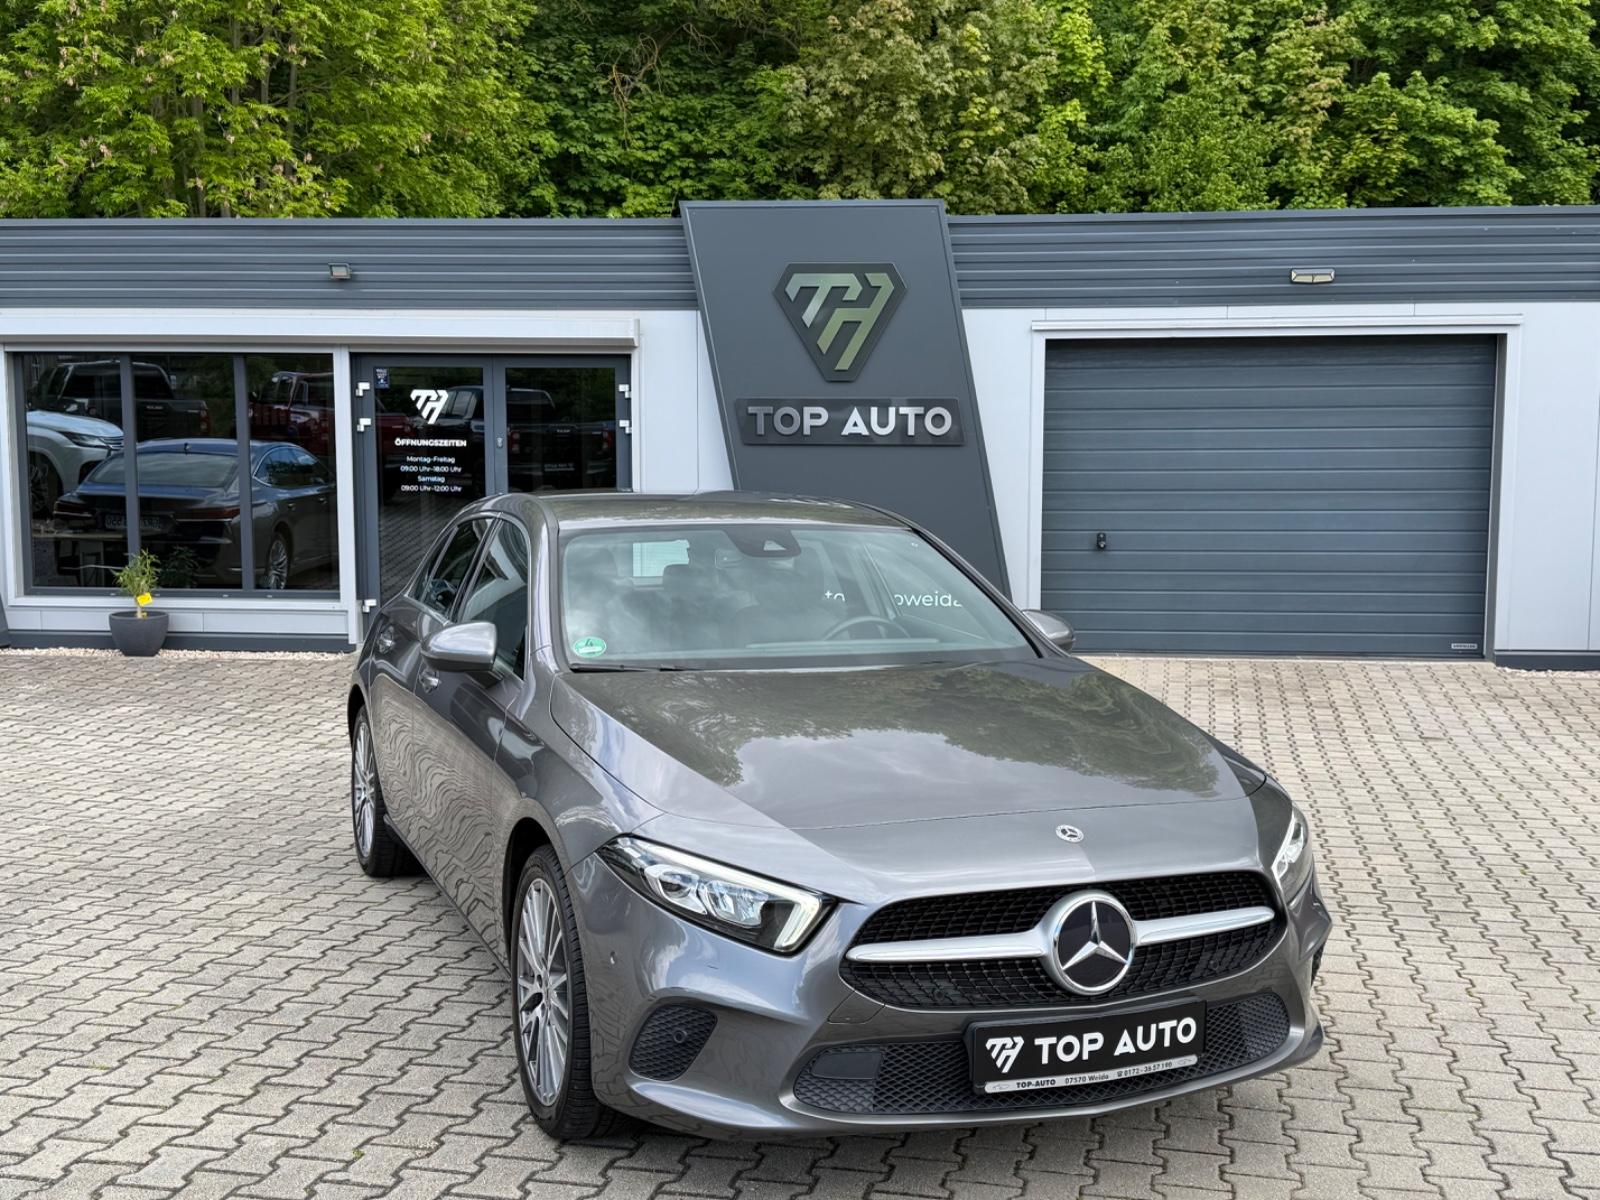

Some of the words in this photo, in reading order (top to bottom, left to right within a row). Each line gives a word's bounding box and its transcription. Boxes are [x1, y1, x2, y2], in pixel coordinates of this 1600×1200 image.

[747, 406, 829, 435] TOP
[841, 406, 952, 436] AUTO
[394, 437, 467, 447] ÖFFNUNGSZEITEN
[1034, 1032, 1104, 1064] TOP
[1113, 1017, 1197, 1056] AUTO
[1016, 1079, 1056, 1089] TOP-AUTO
